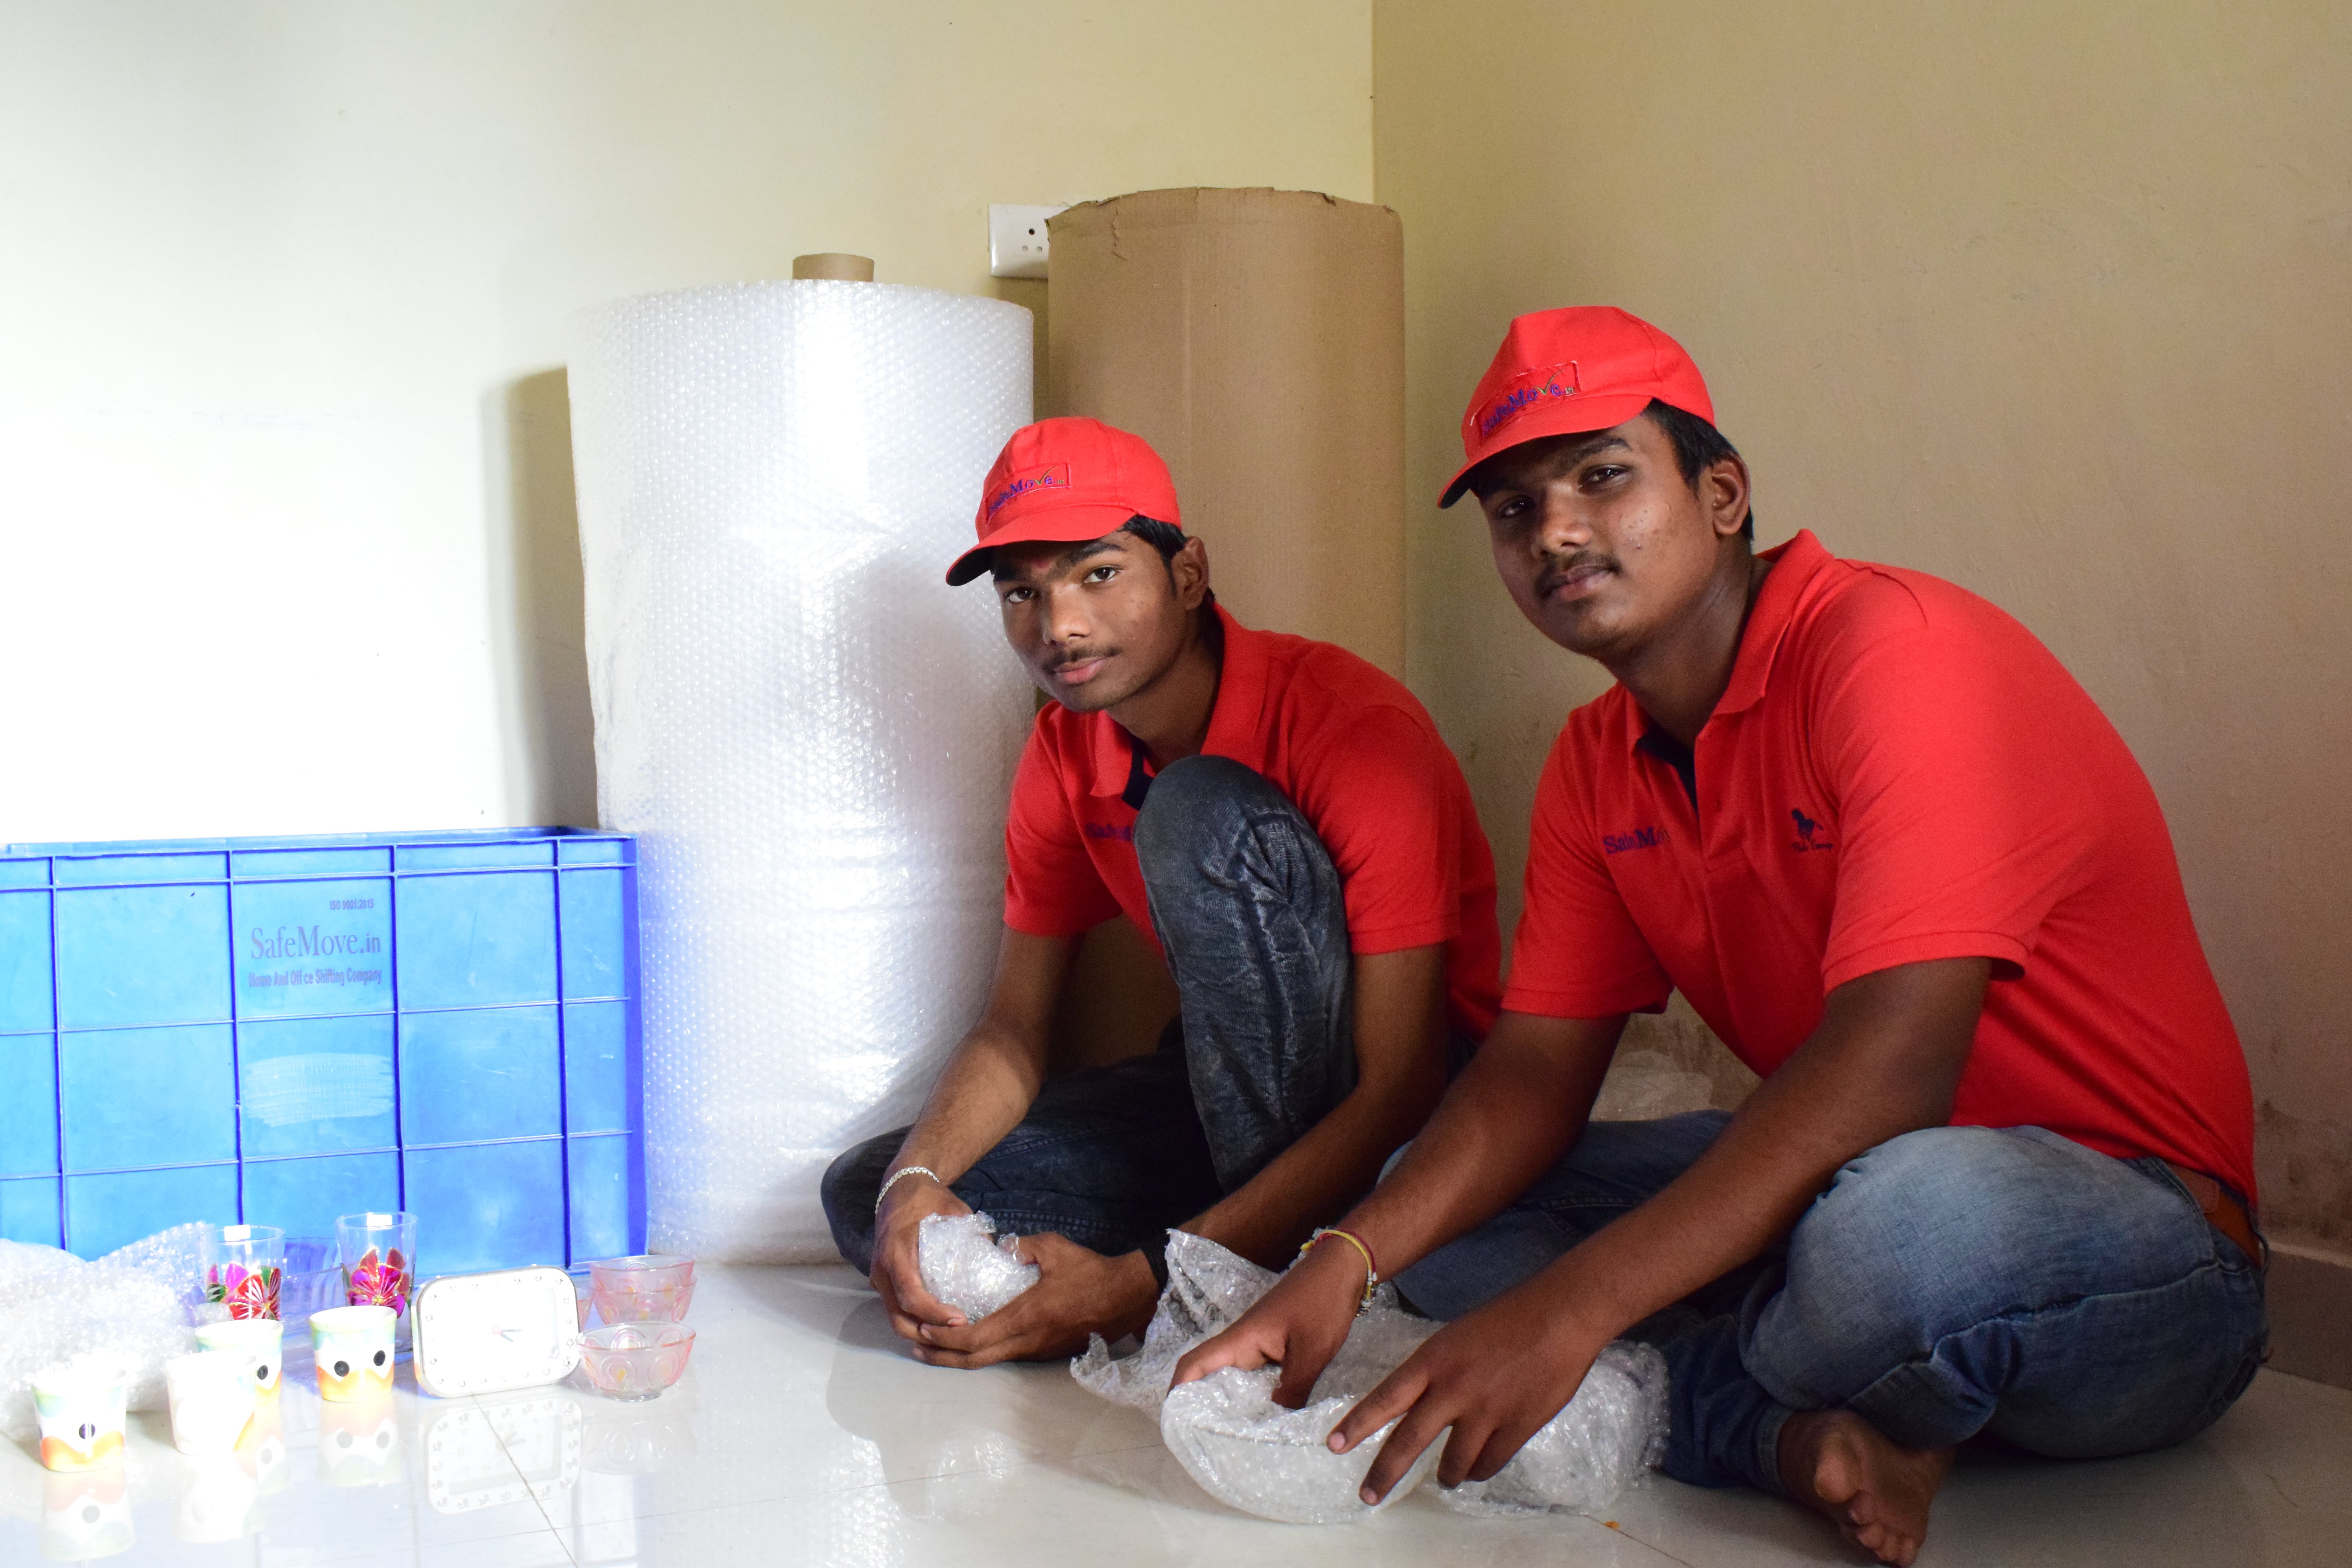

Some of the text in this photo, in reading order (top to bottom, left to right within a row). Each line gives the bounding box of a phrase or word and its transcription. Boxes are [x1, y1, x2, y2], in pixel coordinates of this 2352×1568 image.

[330, 898, 374, 910] ISO 9001:2015
[251, 925, 381, 959] SafeMove.in
[274, 971, 288, 986] And
[316, 968, 344, 987] Shifting
[347, 967, 381, 985] Company
